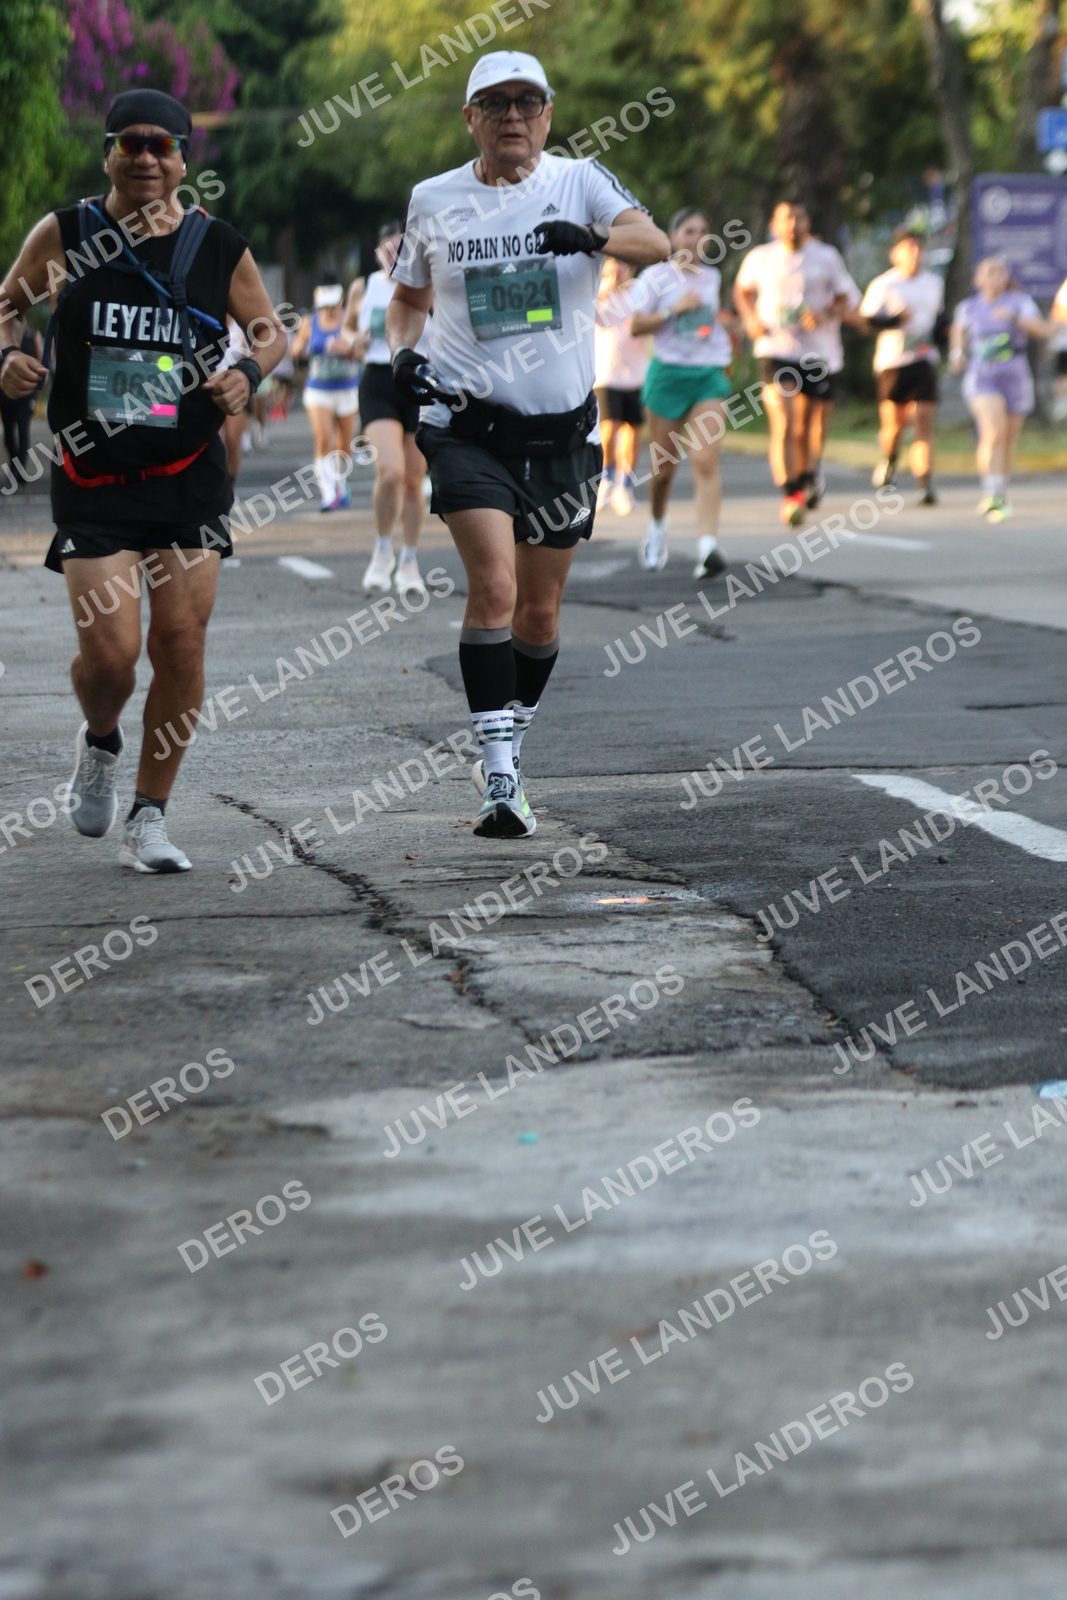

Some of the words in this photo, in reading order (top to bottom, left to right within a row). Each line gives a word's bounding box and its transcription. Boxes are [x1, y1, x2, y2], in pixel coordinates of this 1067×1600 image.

[448, 240, 464, 263] NO
[468, 236, 498, 261] PAIN
[502, 234, 521, 257] NO
[492, 278, 555, 312] 0621
